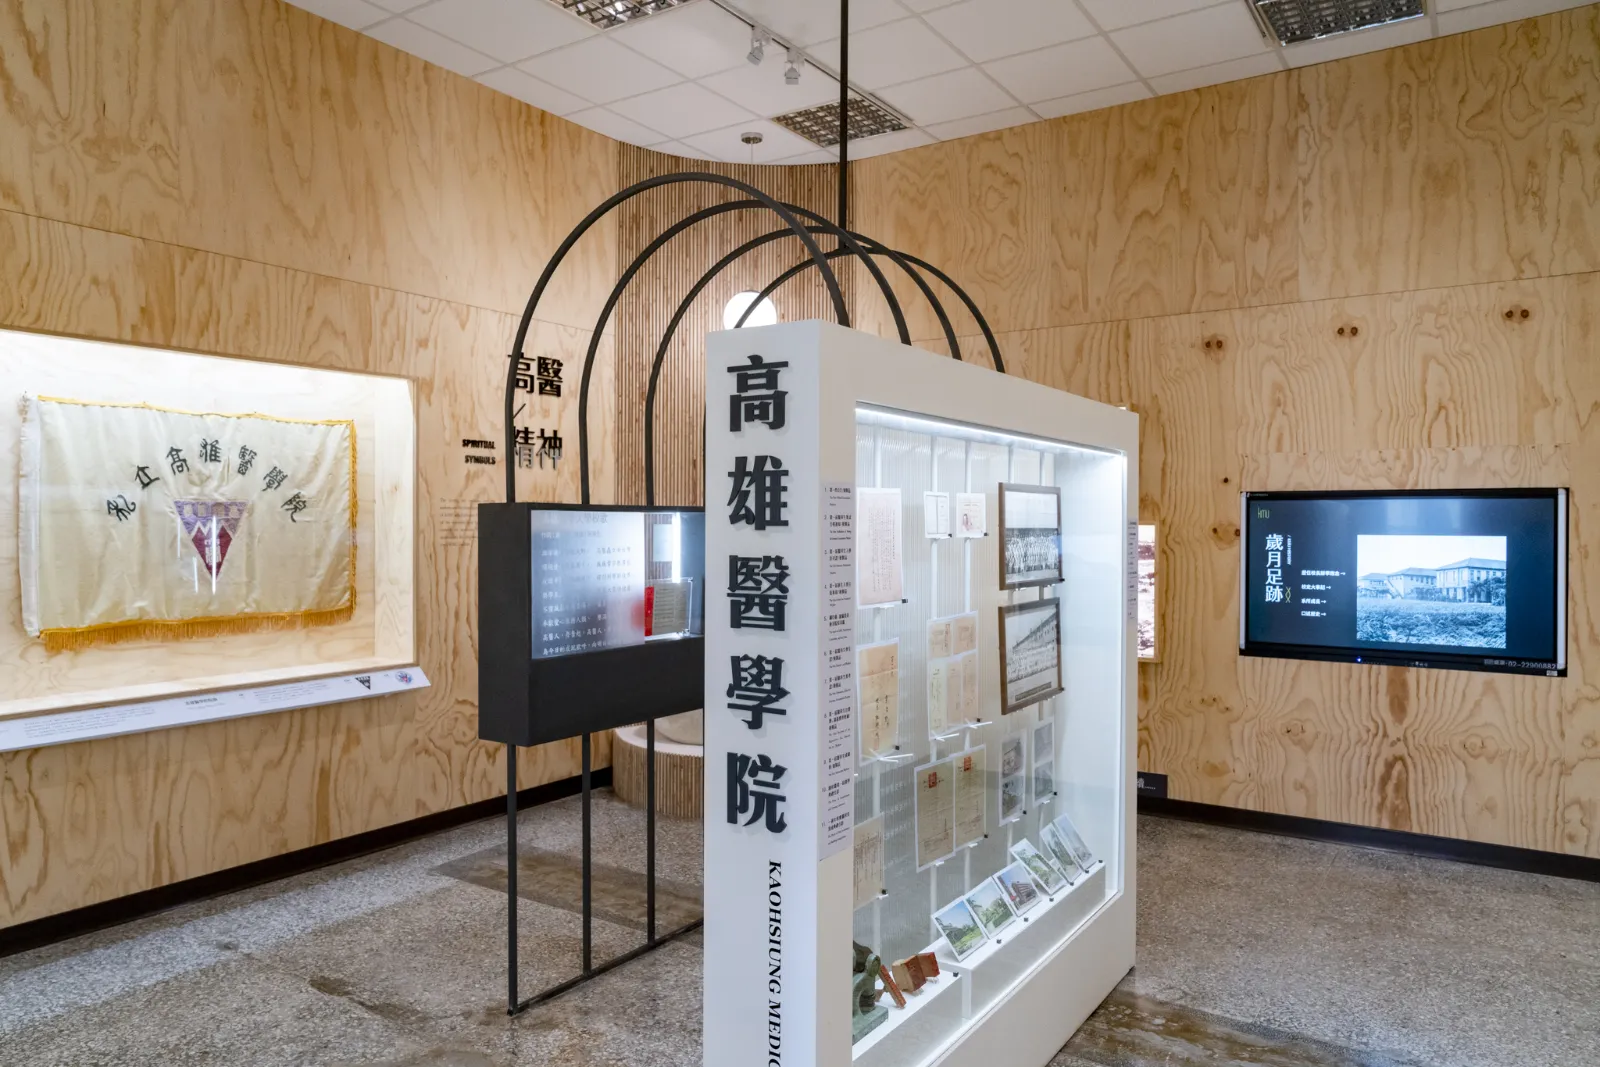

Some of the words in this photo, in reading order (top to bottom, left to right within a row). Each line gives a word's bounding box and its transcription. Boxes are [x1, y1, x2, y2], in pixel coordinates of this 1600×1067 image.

[507, 352, 563, 397] 高醫
[462, 439, 496, 449] SPIRITUAL
[464, 455, 496, 465] SYMBOLS
[513, 426, 562, 470] 精神
[1265, 533, 1284, 602] 歲月足跡
[726, 354, 791, 834] 高雄醫學院
[768, 859, 782, 994] KAOHSIUNG
